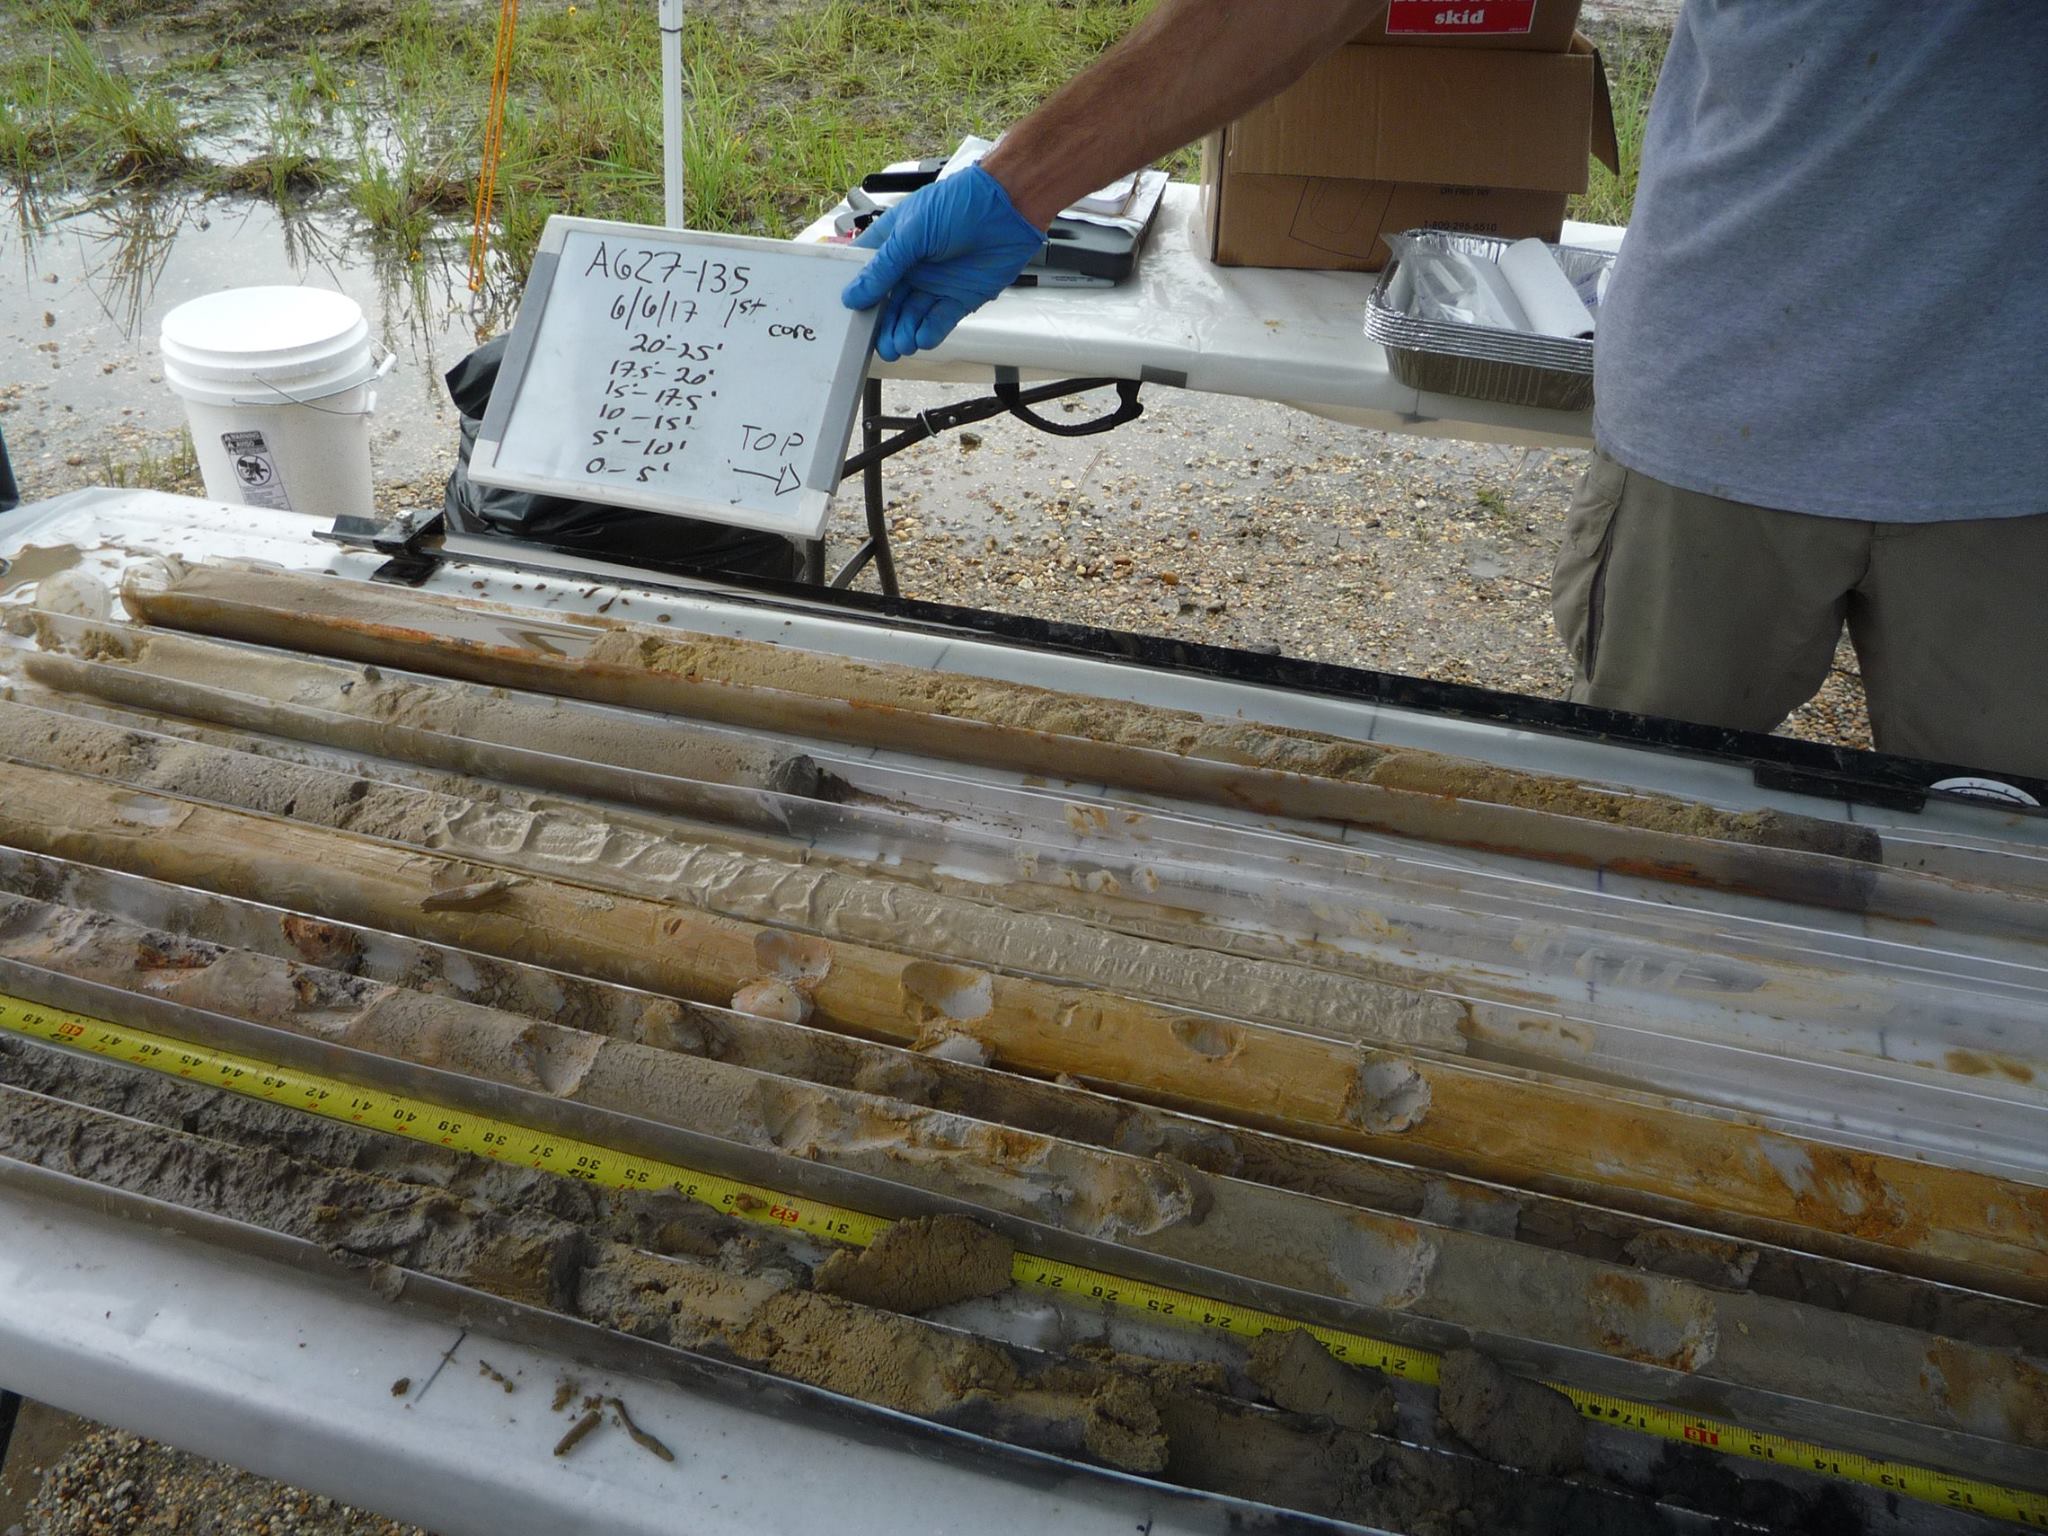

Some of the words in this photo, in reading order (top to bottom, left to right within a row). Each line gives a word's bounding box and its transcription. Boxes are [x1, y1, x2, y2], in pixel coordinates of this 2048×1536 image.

[1434, 9, 1485, 25] skid
[585, 241, 751, 295] A627-135
[611, 286, 698, 330] 6/6/17
[723, 298, 767, 328] 1st
[768, 324, 817, 342] core
[742, 425, 804, 456] TOP
[22, 1014, 44, 1025] 49
[99, 1034, 122, 1046] 47
[139, 1044, 162, 1057] 46
[181, 1055, 203, 1067] 45
[220, 1065, 245, 1077] 44
[263, 1076, 287, 1089] 43
[305, 1087, 330, 1100] 42
[351, 1098, 374, 1111] 41
[393, 1109, 417, 1122] 40
[437, 1120, 462, 1134] 39
[482, 1132, 507, 1146] 38
[529, 1144, 554, 1158] 37
[576, 1156, 601, 1170] 36
[624, 1169, 649, 1183] 35
[771, 1206, 797, 1221] 32
[826, 1220, 850, 1235] 31
[1035, 1273, 1063, 1288] 27
[1091, 1286, 1119, 1301] 26
[1147, 1300, 1175, 1314] 25
[1203, 1312, 1231, 1328] 24
[1381, 1356, 1407, 1371] 21
[1623, 1415, 1646, 1428] 17
[1750, 1444, 1775, 1458] 15
[1814, 1459, 1840, 1474] 14
[1880, 1474, 1907, 1489] 13
[1947, 1489, 1974, 1504] 12
